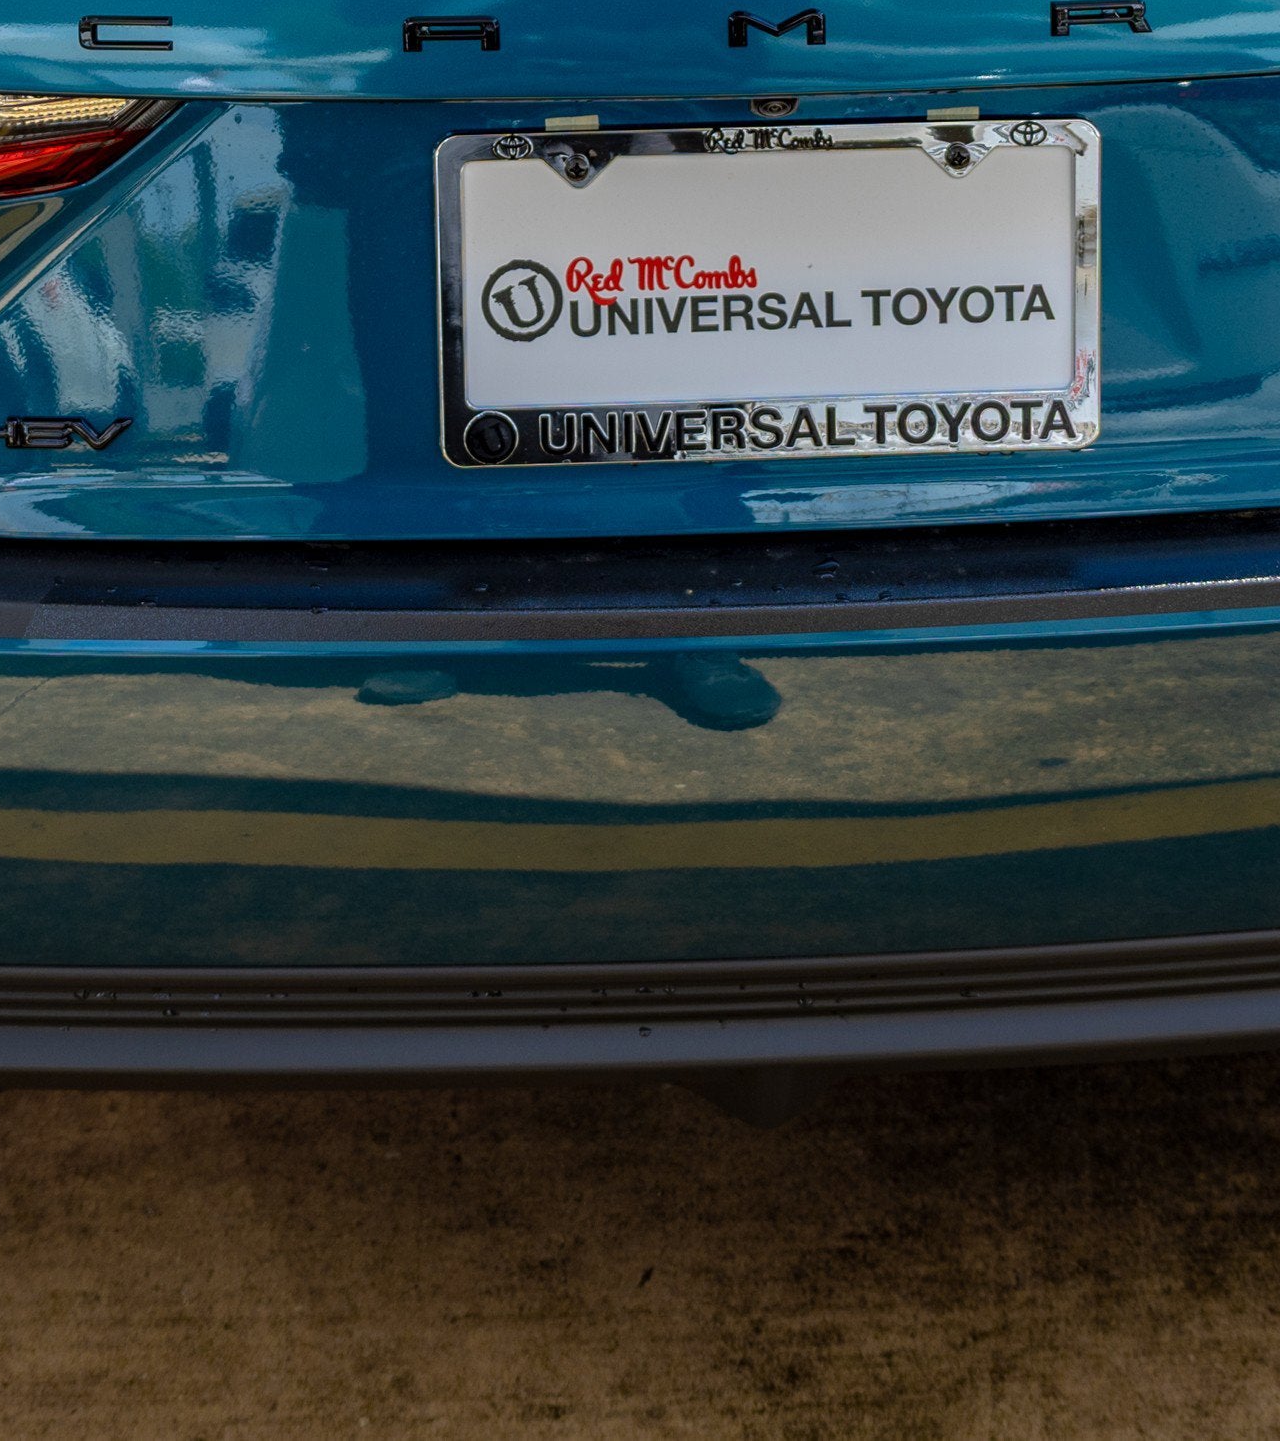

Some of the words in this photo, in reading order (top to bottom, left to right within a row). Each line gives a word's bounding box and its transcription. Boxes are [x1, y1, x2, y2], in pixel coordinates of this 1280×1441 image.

[703, 128, 745, 155] Red
[565, 256, 624, 306] Red
[627, 254, 758, 292] McCombs
[569, 290, 853, 338] UNIVERSAL
[860, 283, 1056, 327] TOYOTA
[538, 403, 857, 456] UNIVERSAL
[862, 397, 1077, 445] TOYOTA
